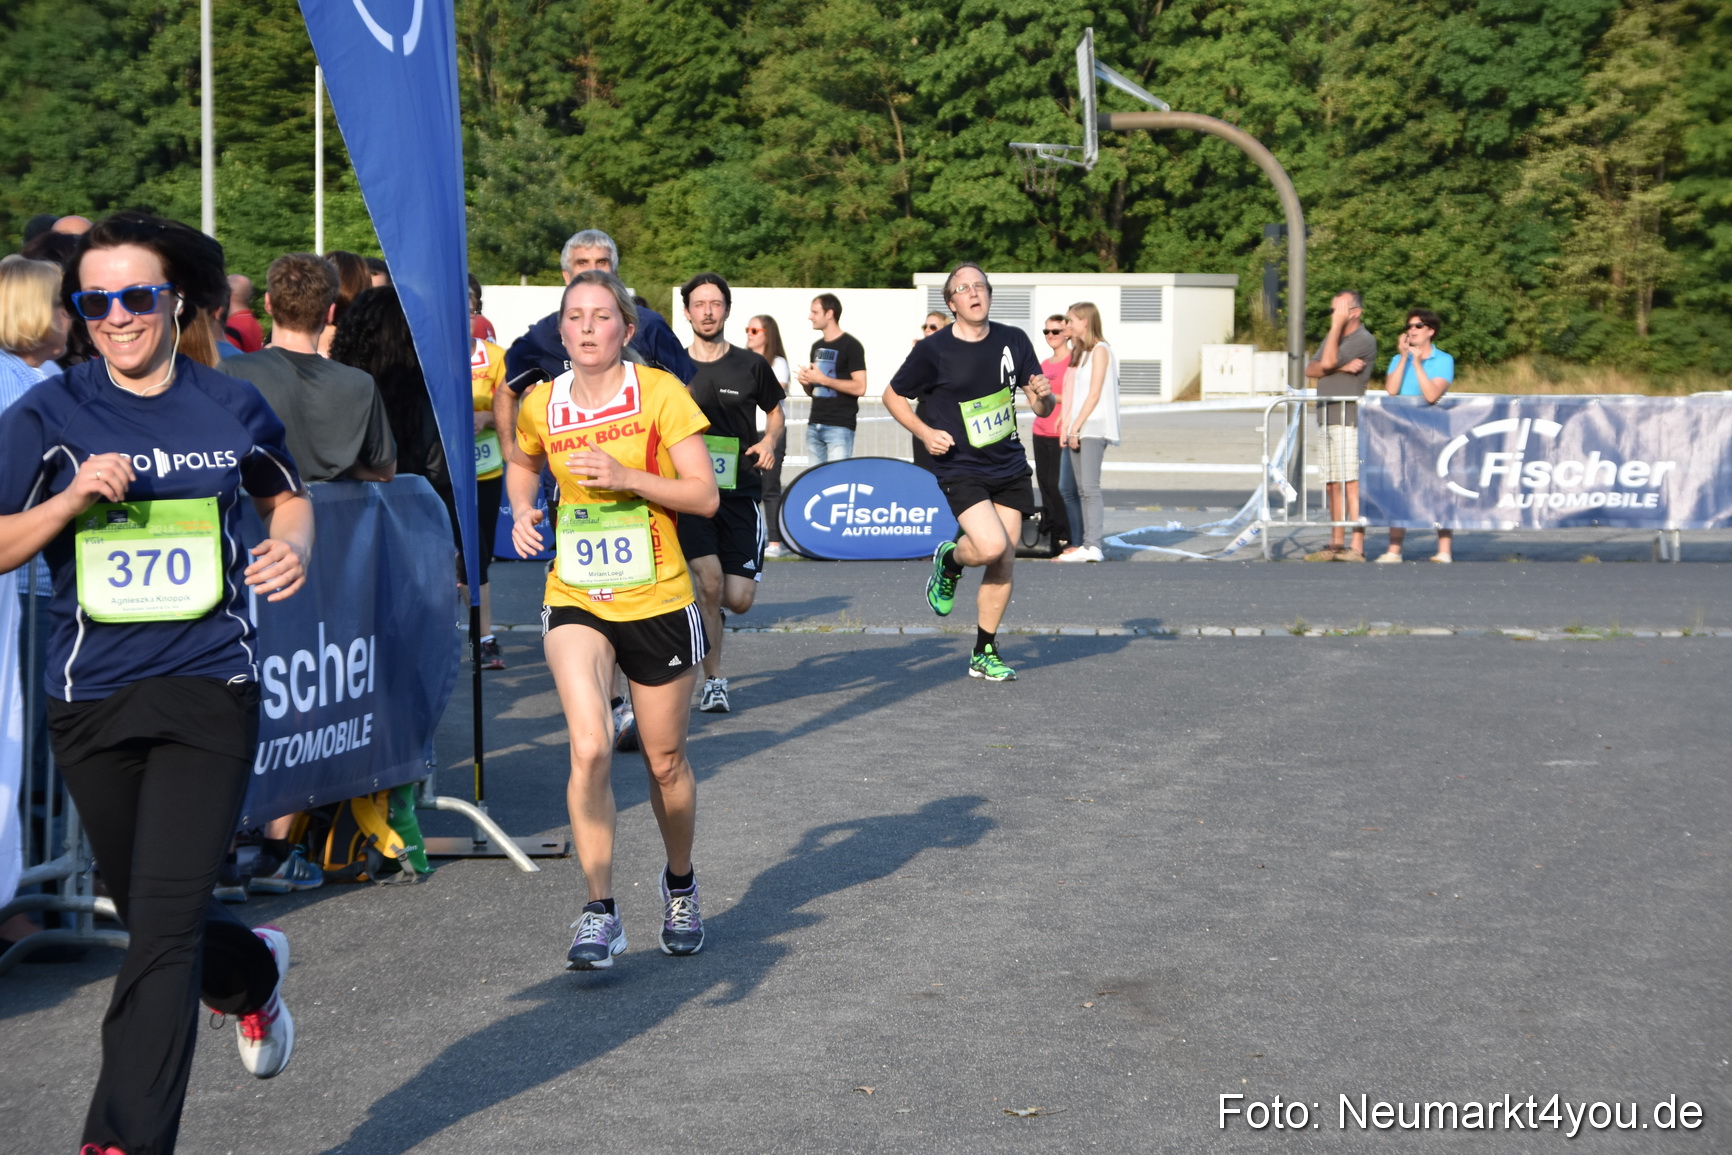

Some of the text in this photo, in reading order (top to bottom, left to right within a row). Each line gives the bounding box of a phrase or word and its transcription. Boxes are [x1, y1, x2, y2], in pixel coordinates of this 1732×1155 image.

[972, 407, 1011, 434] 1144
[550, 421, 646, 455] MAX BÖGL
[173, 450, 238, 471] POLES
[1479, 450, 1676, 488] Fischer
[830, 502, 939, 525] Fischer
[1497, 492, 1660, 509] AUTOMOBILE
[842, 525, 932, 537] AUTOMOBILE
[576, 536, 633, 566] 918
[107, 547, 191, 588] 370
[254, 712, 373, 775] UTOMOBILE
